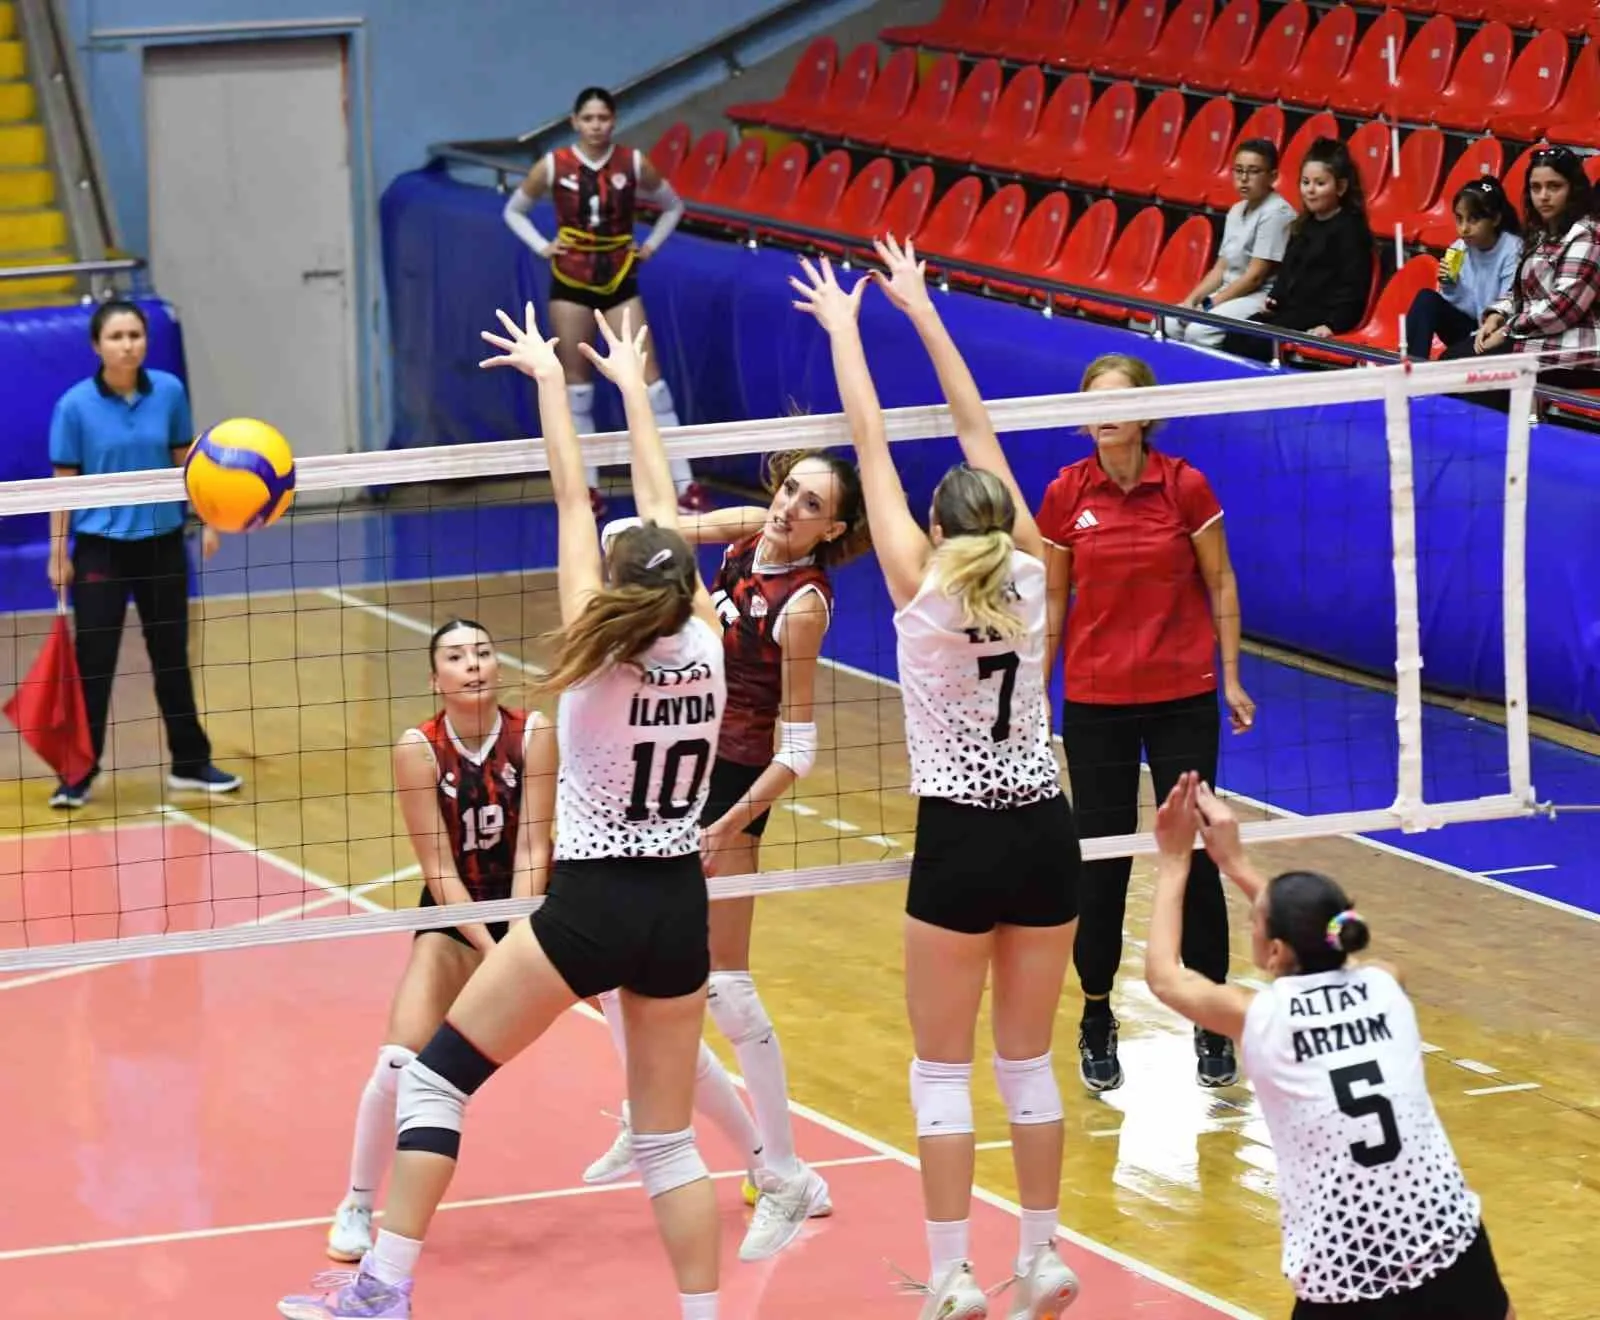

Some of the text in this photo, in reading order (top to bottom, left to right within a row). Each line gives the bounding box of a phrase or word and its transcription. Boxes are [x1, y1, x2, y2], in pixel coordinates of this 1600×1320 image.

[588, 194, 600, 227] 1
[629, 692, 716, 726] İLAYDA
[977, 651, 1020, 743] 7
[624, 738, 710, 821] 10
[462, 804, 505, 852] 19
[1289, 982, 1369, 1018] ALTAY
[1292, 1013, 1393, 1063] ARZUM
[1329, 1060, 1402, 1168] 5
